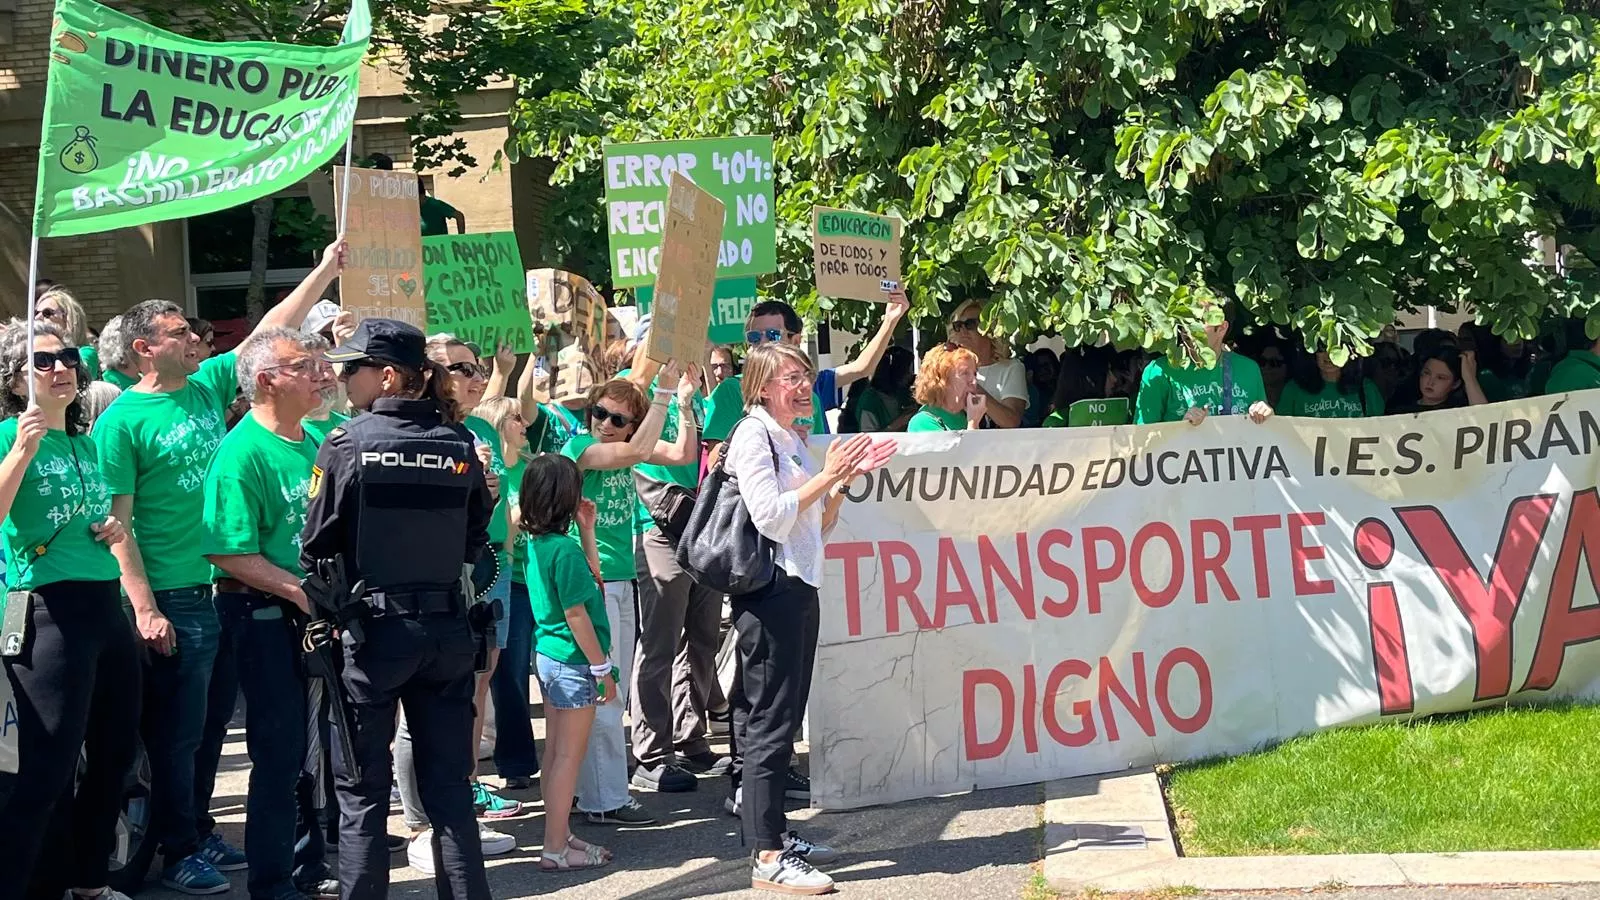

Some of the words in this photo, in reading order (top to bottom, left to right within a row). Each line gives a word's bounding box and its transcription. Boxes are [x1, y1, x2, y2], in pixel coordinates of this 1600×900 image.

[105, 37, 269, 94] DINERO
[101, 83, 156, 127] LA
[170, 96, 300, 142] EDUCA
[72, 157, 288, 211] BACHILLERATO
[607, 153, 697, 189] ERROR
[712, 149, 772, 185] 404:
[737, 193, 768, 226] NO
[822, 214, 891, 238] EDUCACIÓN
[422, 243, 448, 266] ON
[451, 233, 514, 268] RAMÓN
[617, 238, 752, 277] ENCADO
[820, 242, 837, 256] DE
[840, 244, 873, 262] TODOS
[880, 248, 887, 261] Y
[368, 274, 390, 296] SE
[438, 265, 503, 297] CAJAL
[820, 258, 849, 276] PARA
[855, 262, 888, 279] TODOS
[425, 288, 506, 325] ESTARÍA
[1089, 404, 1107, 414] NO
[1304, 399, 1340, 413] ESCUELA
[361, 452, 456, 470] POLICIA
[847, 462, 1075, 503] OMUNIDAD
[1081, 446, 1292, 490] EDUCATIVA
[1314, 431, 1436, 477] I.E.S.
[60, 483, 79, 499] DE
[824, 511, 1336, 636] TRANSPORTE
[962, 646, 1213, 762] DIGNO
